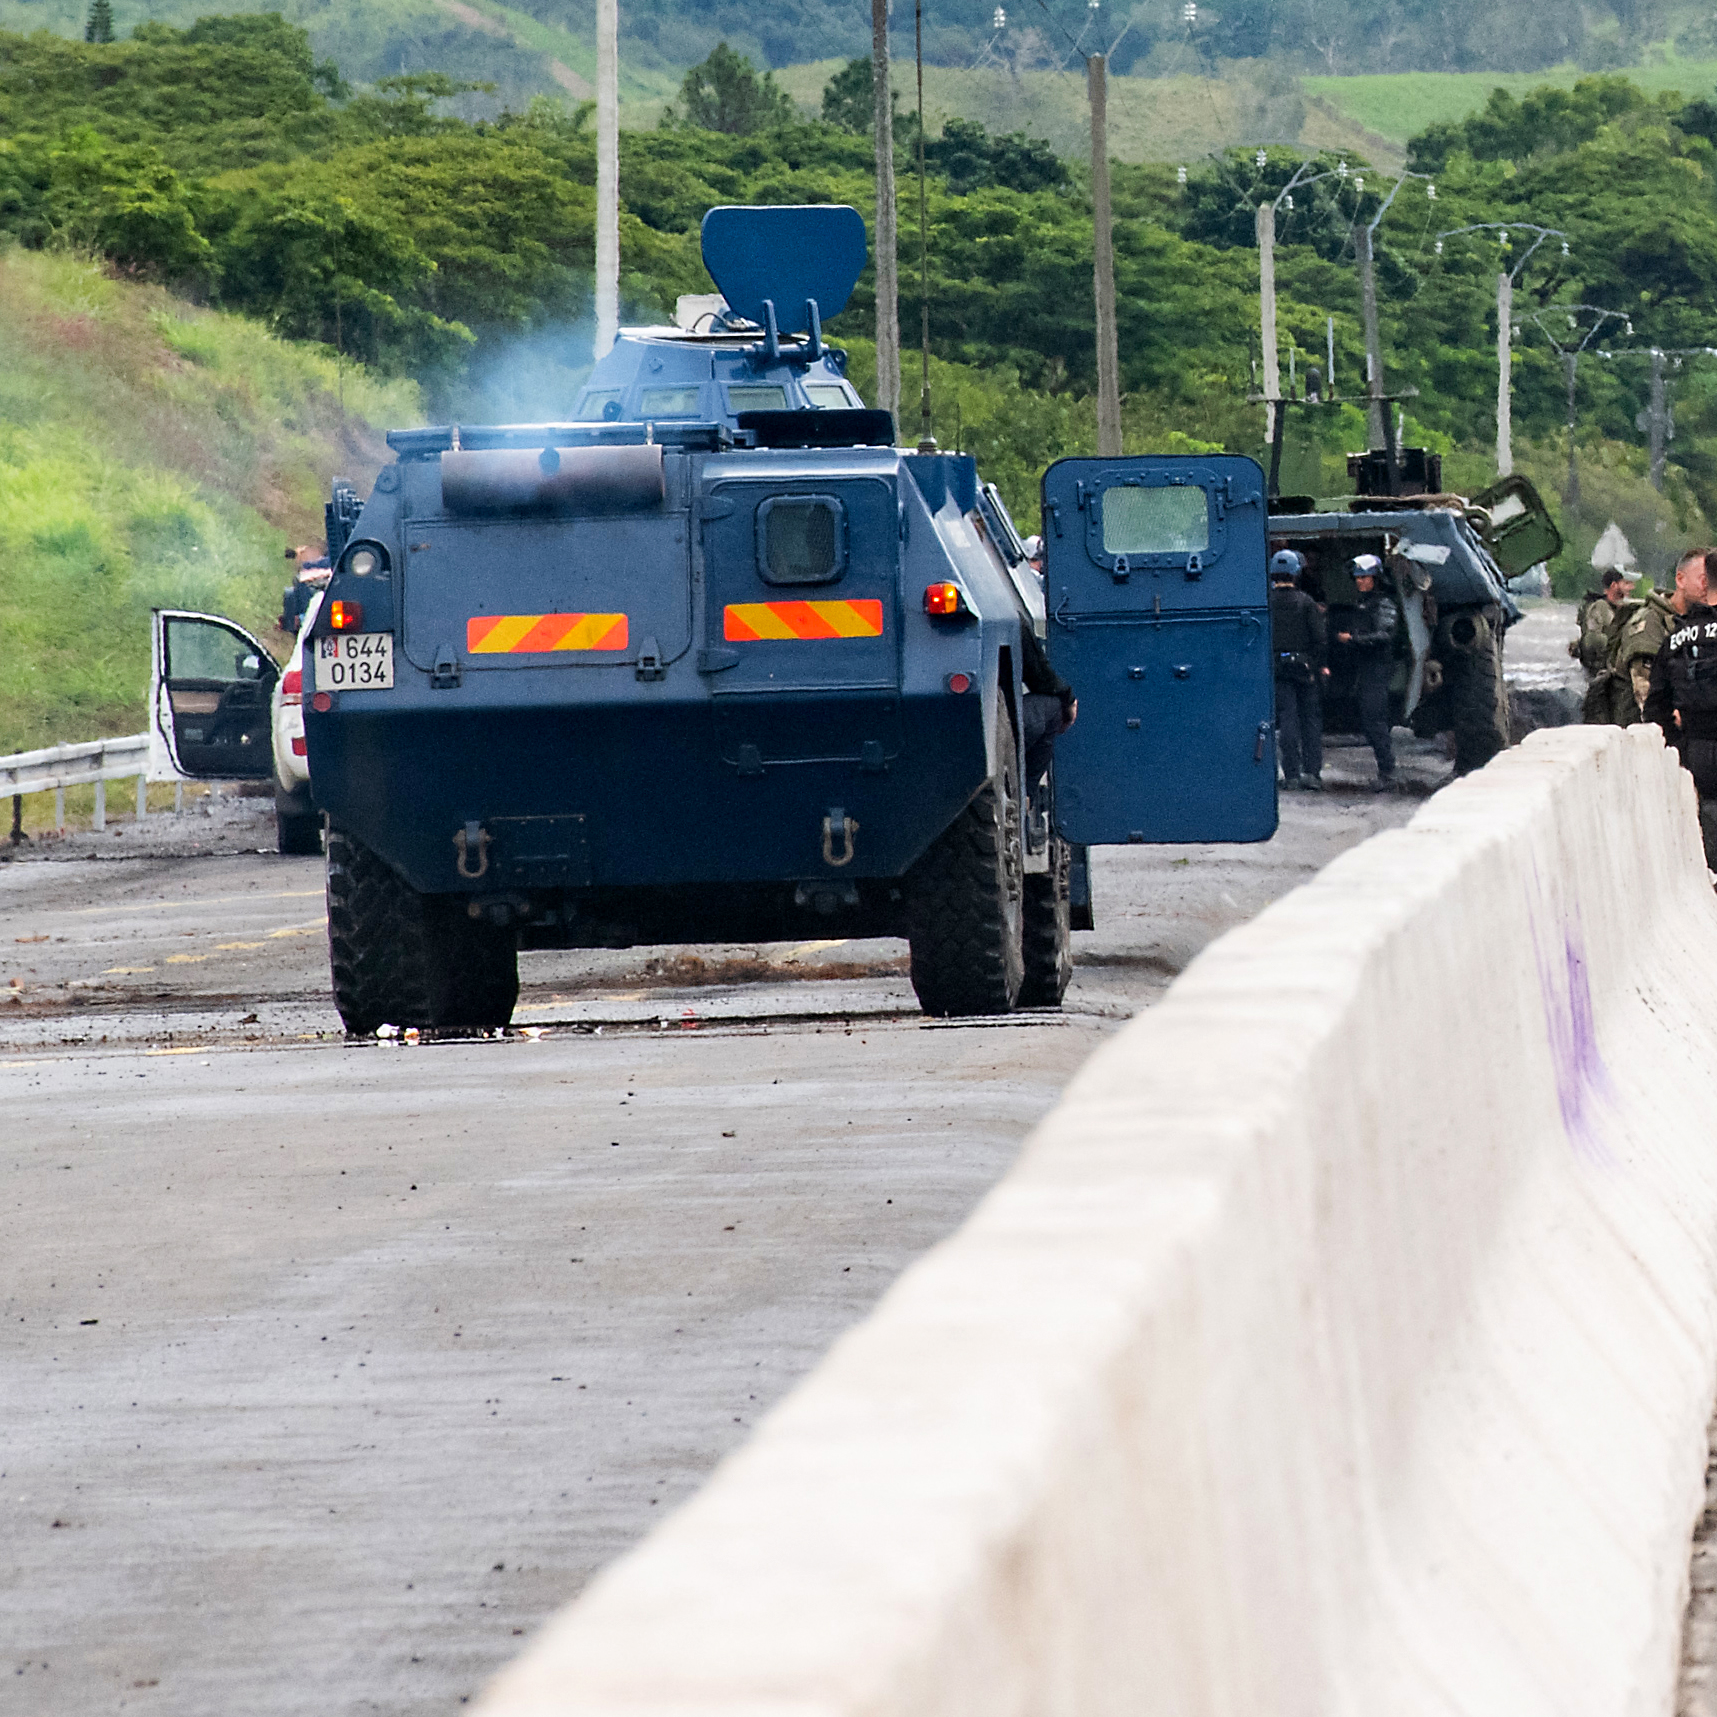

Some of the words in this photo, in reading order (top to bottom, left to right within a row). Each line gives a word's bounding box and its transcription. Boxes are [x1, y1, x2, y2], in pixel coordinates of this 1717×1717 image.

[346, 635, 387, 659] 644
[1669, 625, 1699, 651] ECHO
[331, 660, 387, 684] 0134
